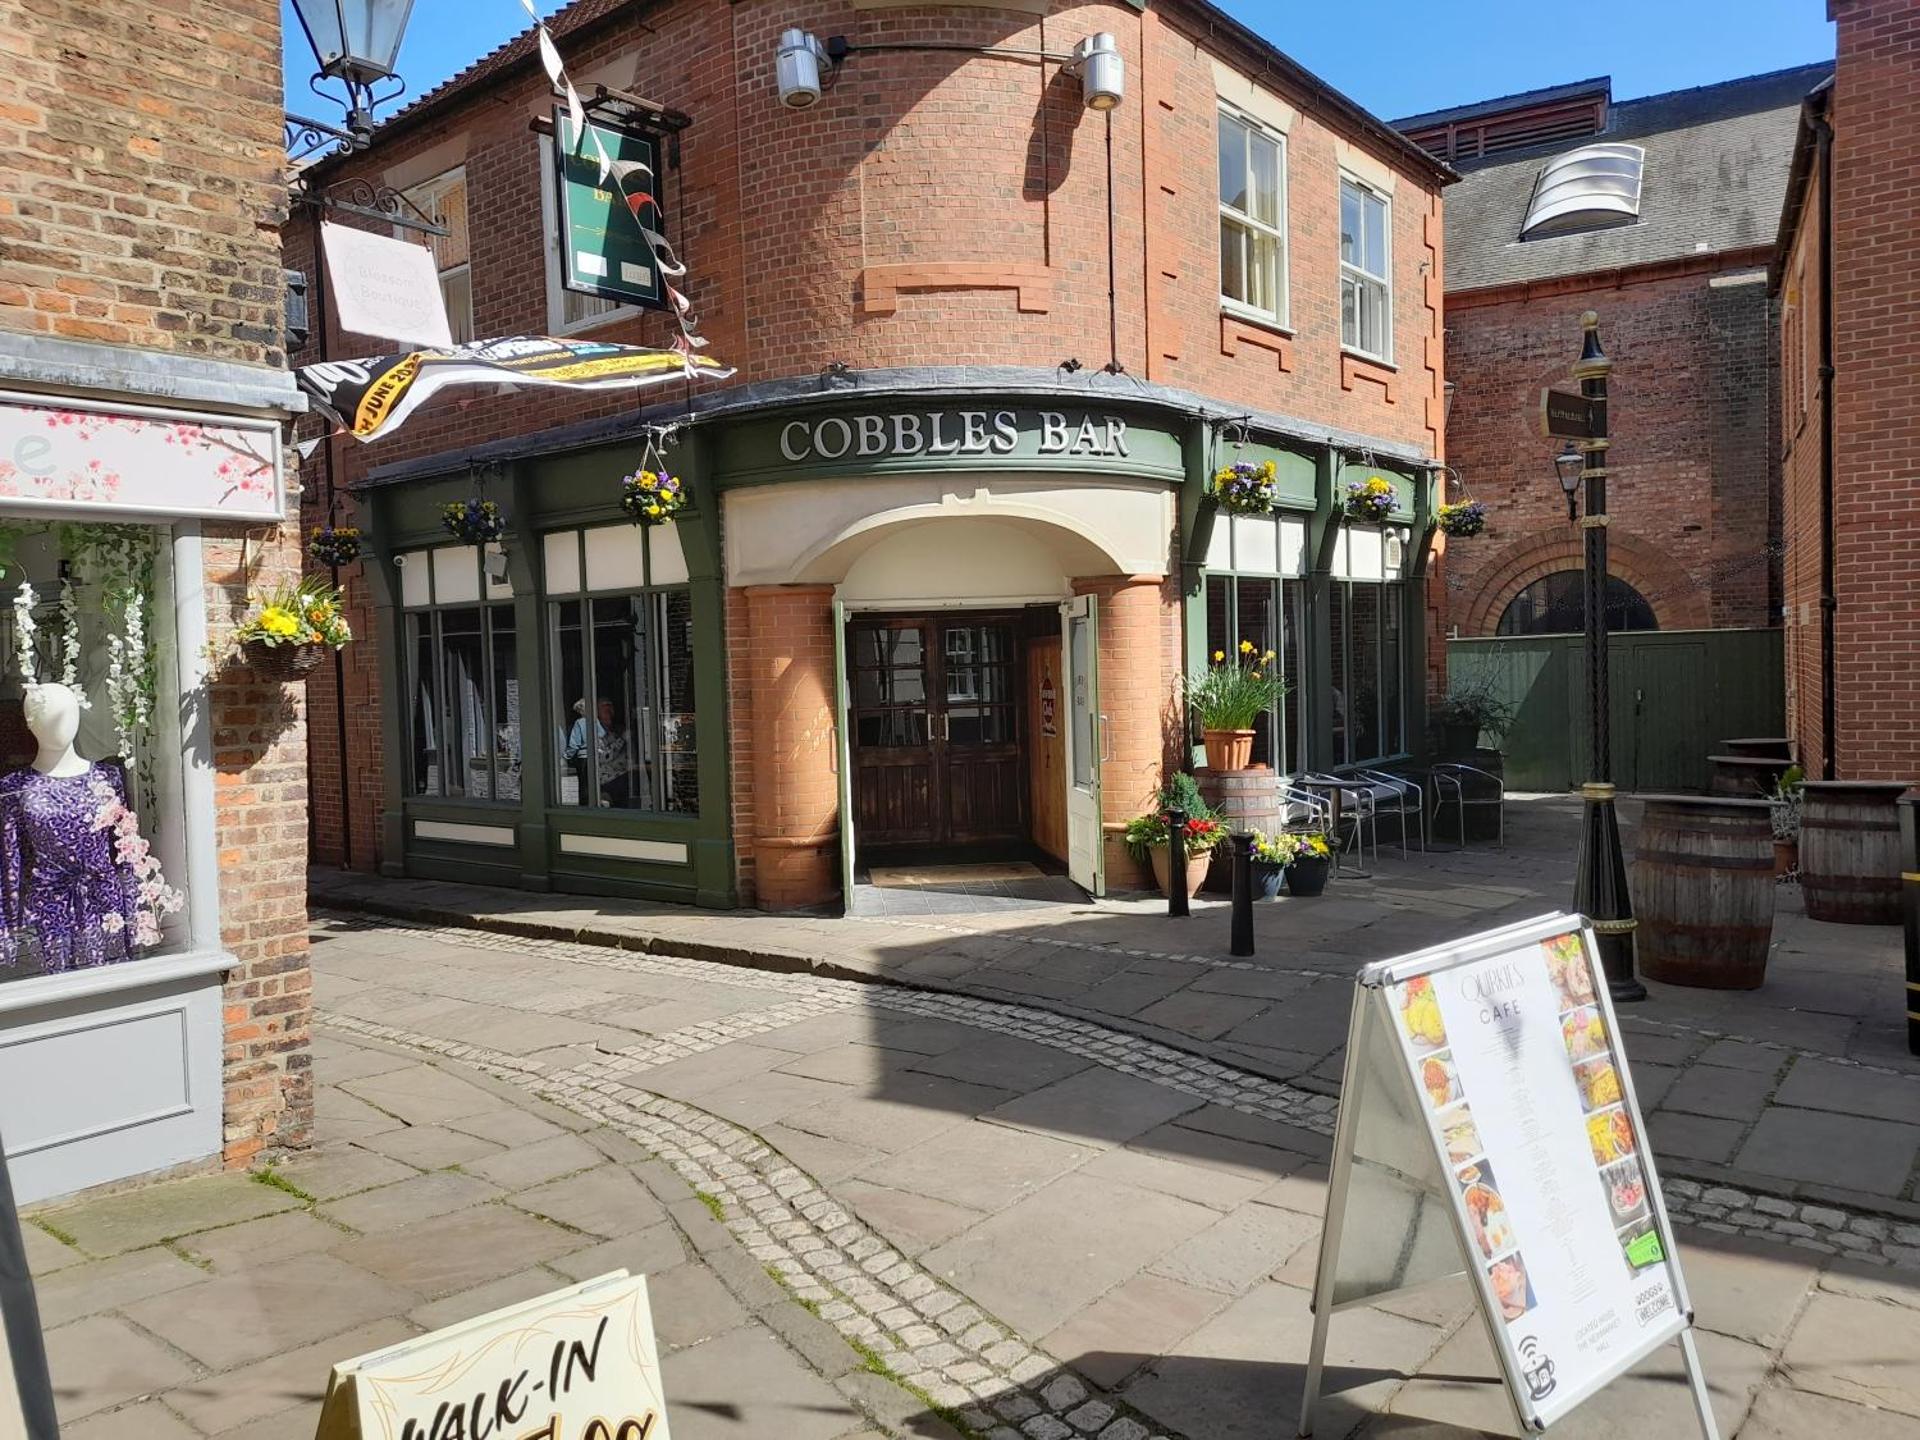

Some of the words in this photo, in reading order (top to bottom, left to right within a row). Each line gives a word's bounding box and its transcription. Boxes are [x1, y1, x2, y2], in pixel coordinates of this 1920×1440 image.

[365, 381, 396, 419] JUNE
[780, 410, 1019, 461] COBBLES
[1037, 411, 1130, 457] BAR
[1479, 1000, 1521, 1025] CAFE
[1639, 1293, 1671, 1321] WELCOME
